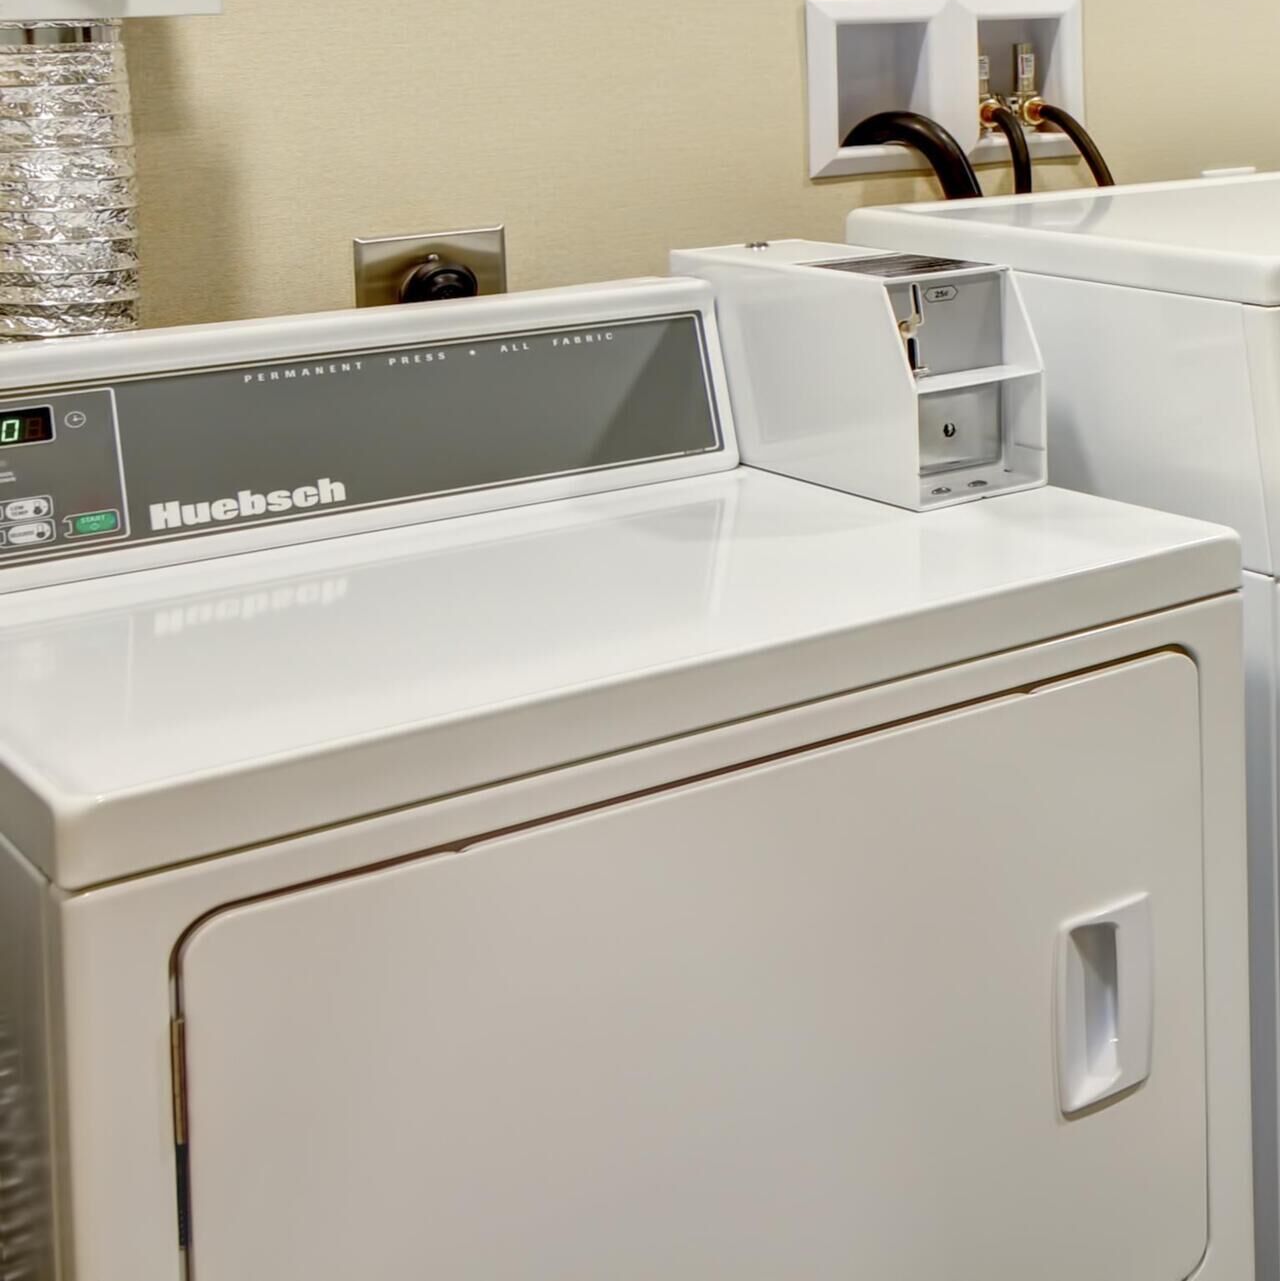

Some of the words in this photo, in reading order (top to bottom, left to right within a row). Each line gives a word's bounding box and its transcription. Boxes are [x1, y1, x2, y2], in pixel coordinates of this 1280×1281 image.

[244, 362, 362, 383] PERMANENT
[389, 352, 446, 366] PRESS
[500, 343, 529, 353] ALL
[552, 332, 613, 346] FABRIC
[149, 477, 347, 531] Huebsch
